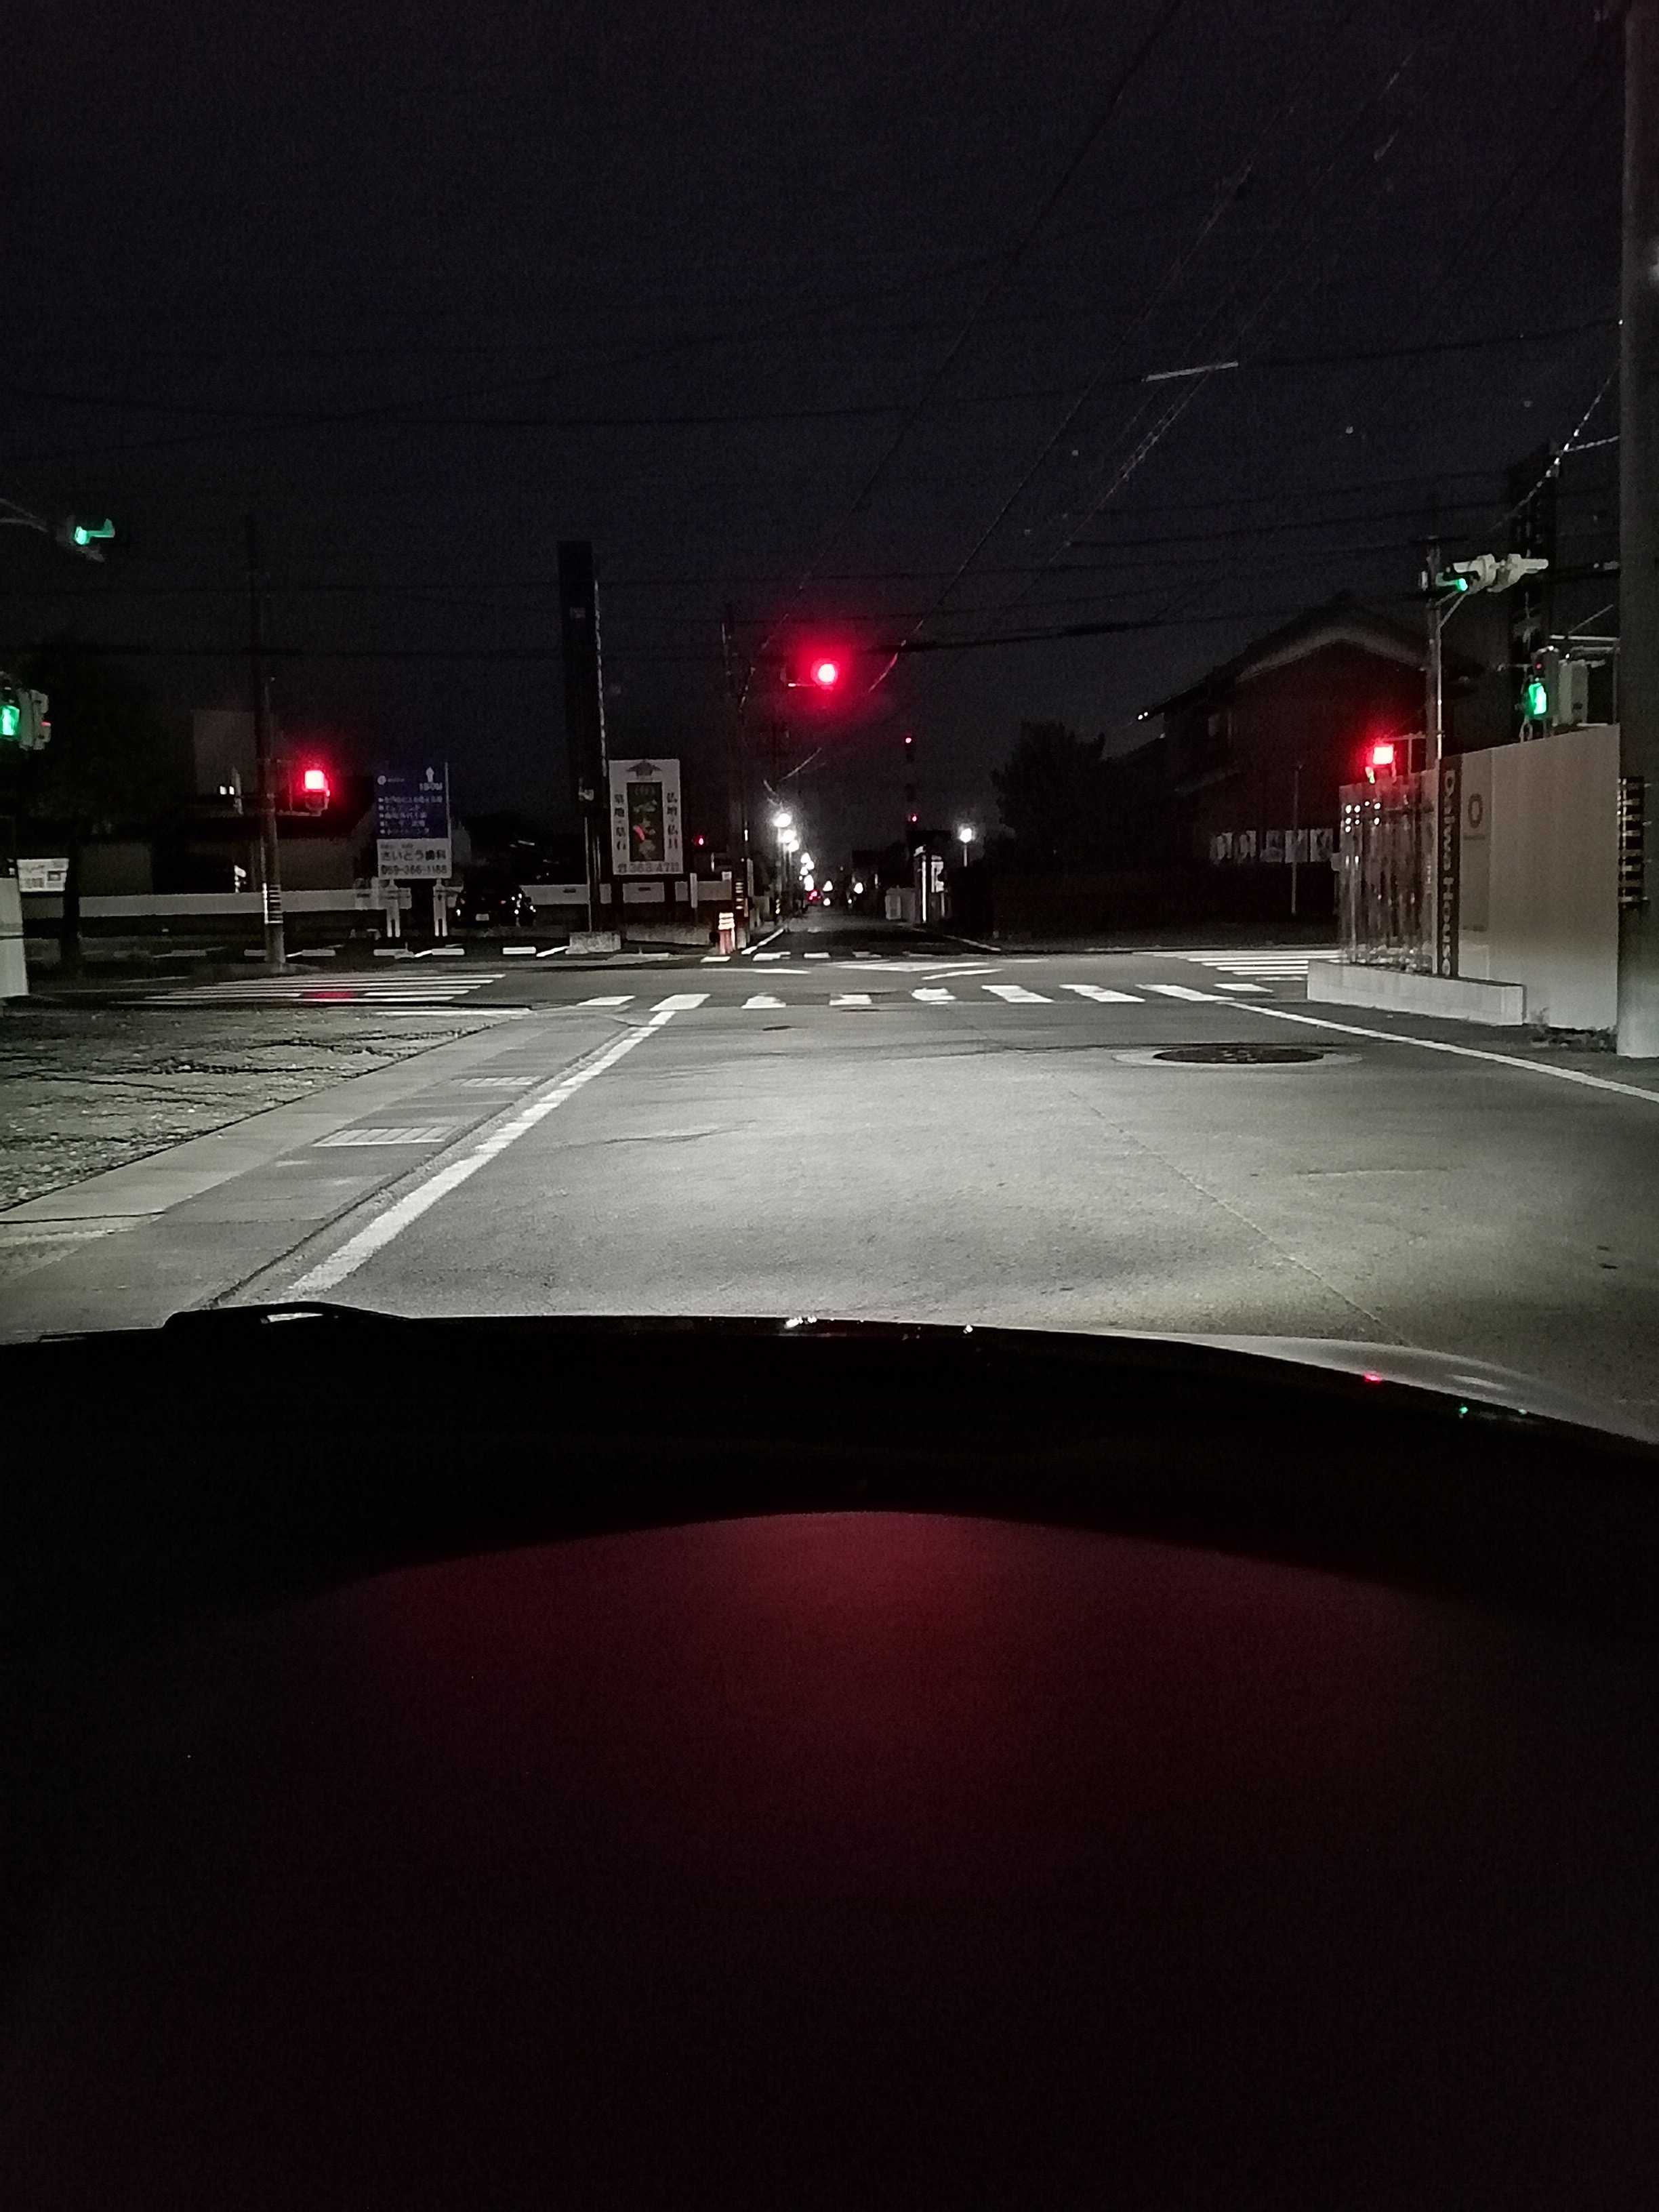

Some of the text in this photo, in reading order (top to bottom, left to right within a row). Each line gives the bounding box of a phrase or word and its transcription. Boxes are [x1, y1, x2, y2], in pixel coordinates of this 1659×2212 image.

[380, 850, 447, 861] さいとう歯科
